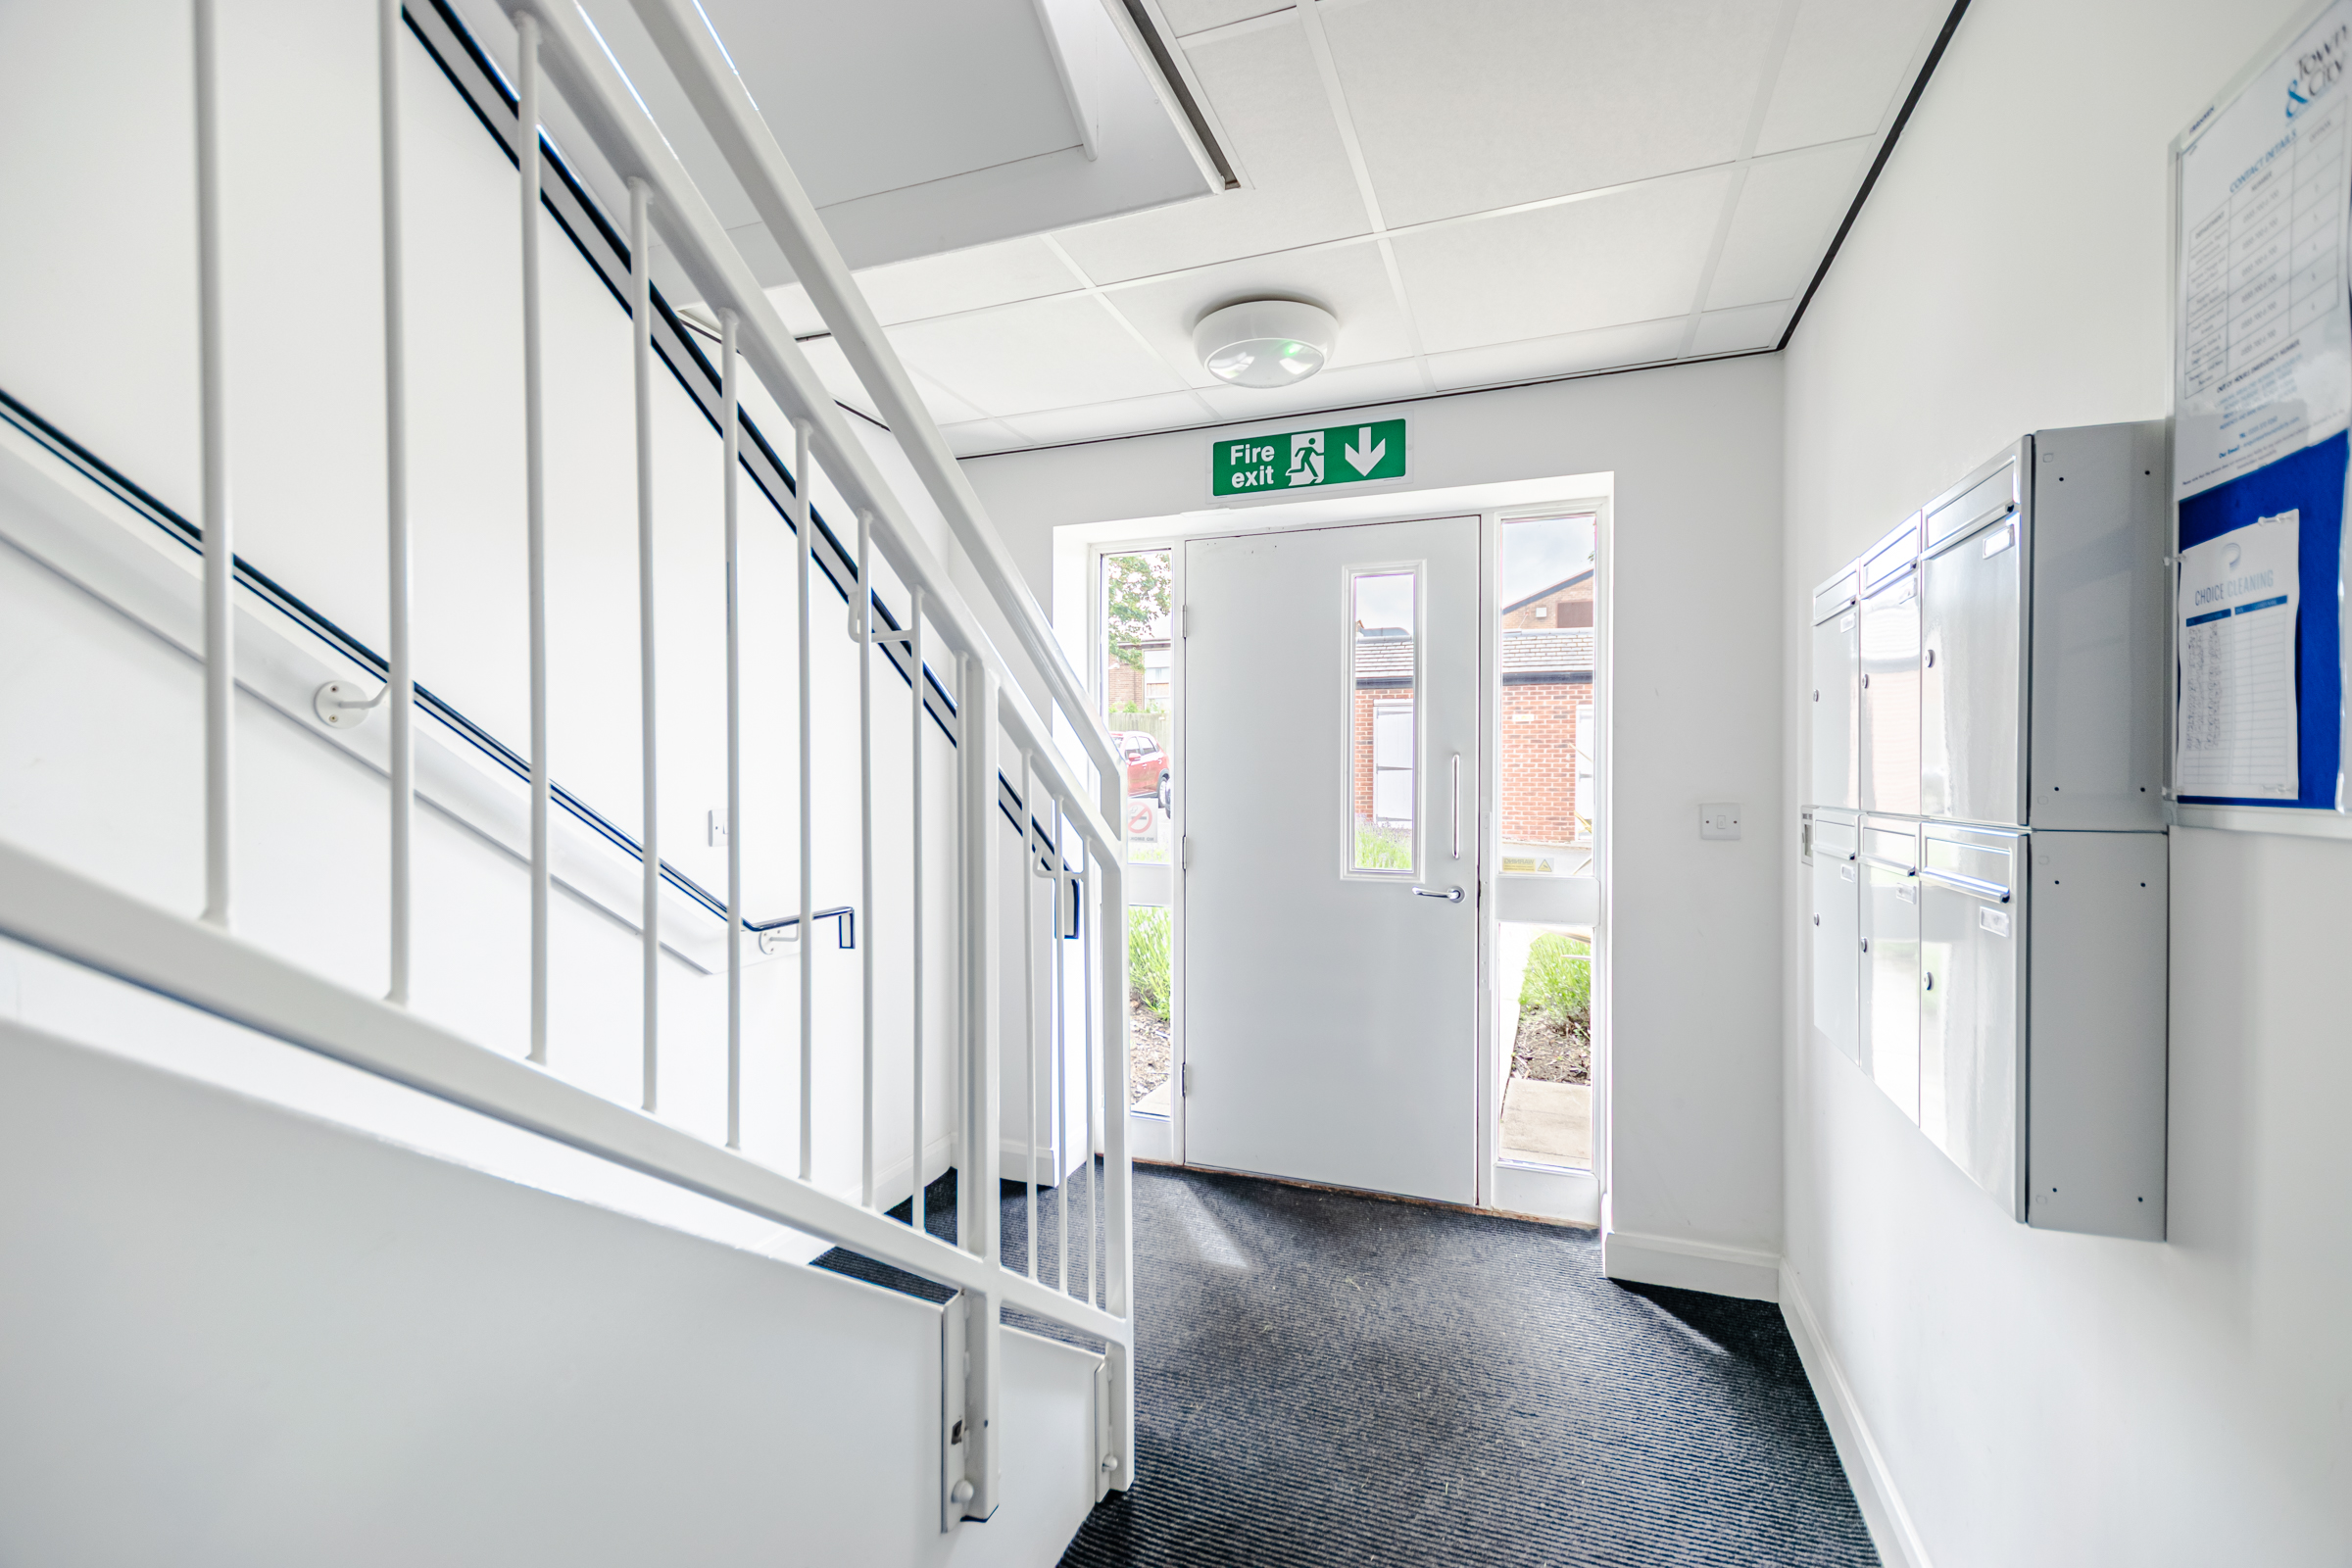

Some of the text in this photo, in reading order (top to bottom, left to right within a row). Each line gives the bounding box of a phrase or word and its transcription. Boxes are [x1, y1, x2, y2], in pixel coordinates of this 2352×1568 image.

[2230, 155, 2264, 193] CONTACT
[1230, 444, 1275, 466] Fire
[1231, 465, 1274, 488] exit
[2195, 569, 2274, 607] CHOICE CLEANING
